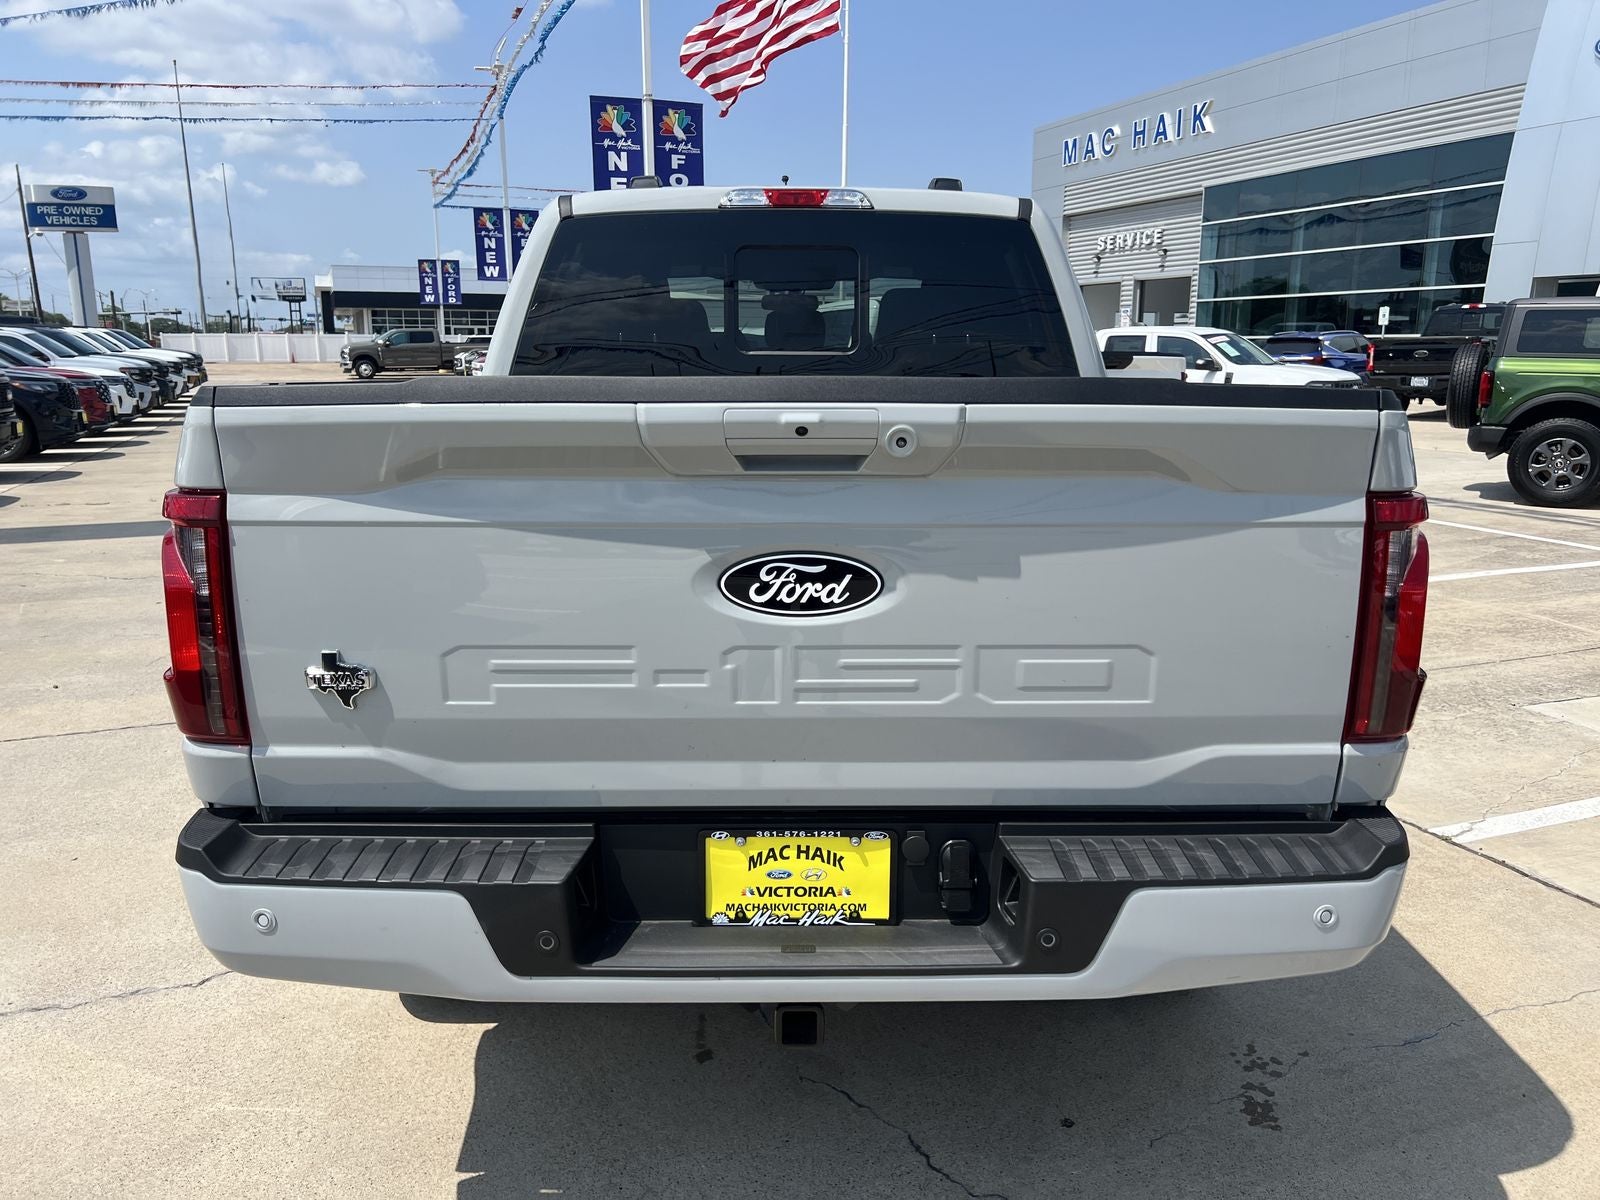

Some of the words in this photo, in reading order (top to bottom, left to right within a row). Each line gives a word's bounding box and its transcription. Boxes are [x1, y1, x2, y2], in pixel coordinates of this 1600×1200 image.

[1062, 126, 1117, 167] MAC
[1131, 100, 1214, 150] HAIK
[607, 151, 628, 190] NE
[669, 154, 689, 187] FO
[57, 188, 78, 198] Ford
[36, 205, 104, 216] PRE-OWNED
[45, 215, 98, 226] VEHICLES
[1097, 228, 1165, 251] SERVICE
[483, 237, 500, 278] NEW
[424, 277, 435, 303] NEW
[447, 277, 457, 304] FORD
[748, 562, 850, 606] Ford
[308, 672, 365, 687] TEXAS
[441, 645, 1157, 706] F-150
[756, 830, 842, 838] 361-576-1221
[748, 844, 791, 872] MAC
[796, 844, 845, 872] HAIK
[756, 886, 837, 898] VICTORIA
[725, 903, 867, 913] MACHAIKVICTORIA.COM
[749, 909, 798, 927] Mac
[798, 909, 850, 927] Haik
